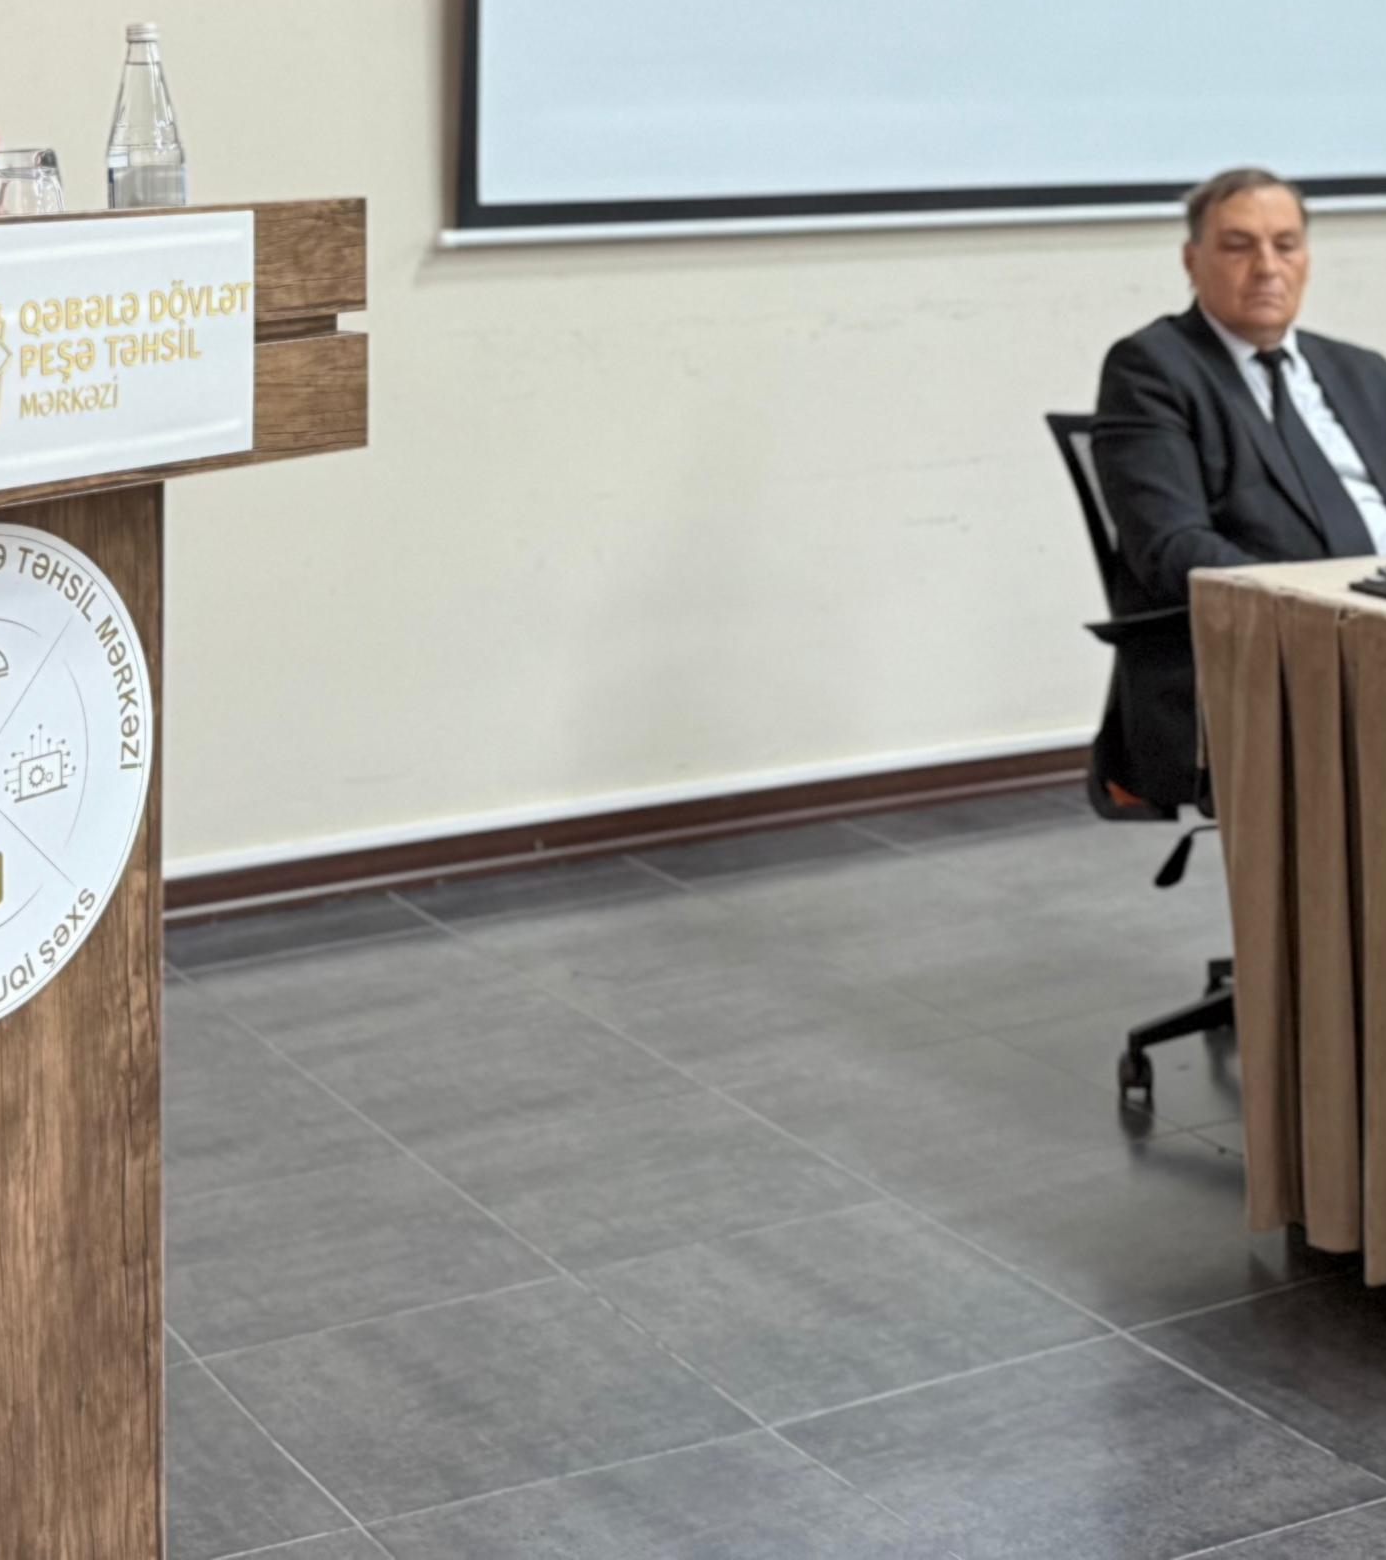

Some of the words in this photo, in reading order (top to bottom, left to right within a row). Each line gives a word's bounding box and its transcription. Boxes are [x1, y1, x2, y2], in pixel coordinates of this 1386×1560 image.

[19, 291, 139, 336] QƏBƏLƏ
[148, 280, 251, 322] DÖVLƏT
[20, 337, 95, 382] PEŞƏ
[104, 320, 201, 368] TƏHSİL
[19, 374, 120, 419] MƏRKƏZİ
[18, 546, 99, 623] TƏHSİL
[95, 615, 144, 773] MƏRKƏZİ
[38, 886, 97, 966] ŞƏXS
